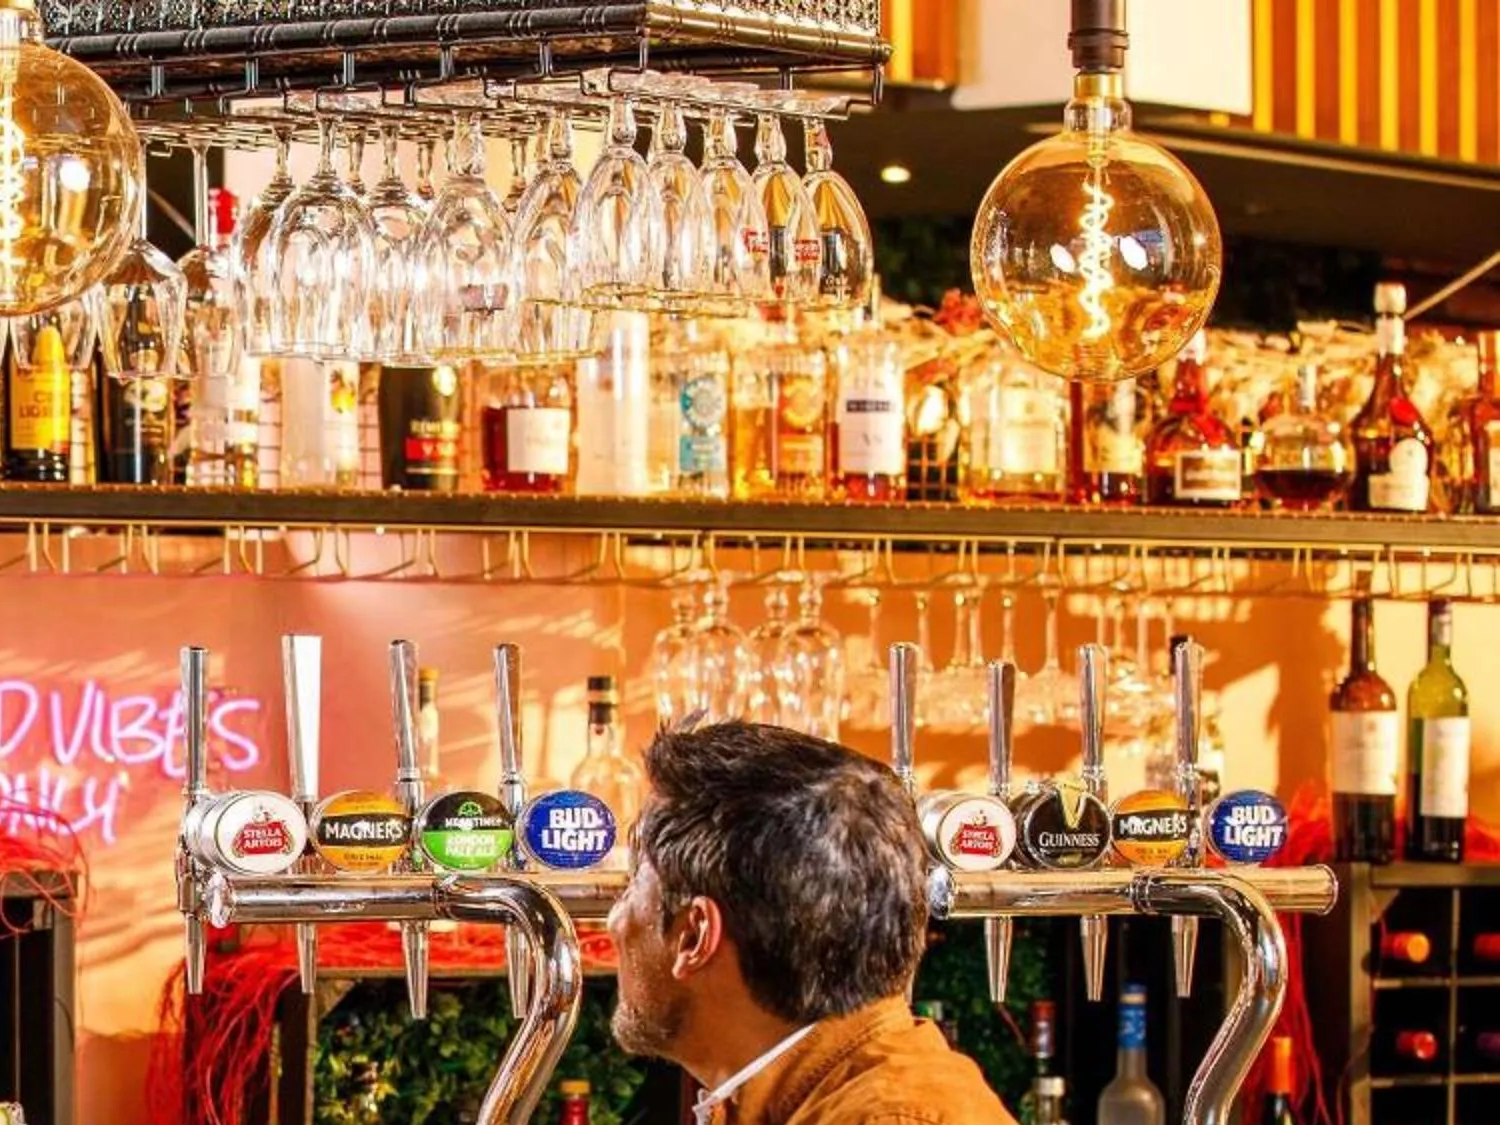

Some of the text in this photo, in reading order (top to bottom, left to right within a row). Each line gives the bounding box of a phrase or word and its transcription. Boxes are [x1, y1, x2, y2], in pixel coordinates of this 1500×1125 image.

[51, 678, 260, 779] VIBES
[549, 808, 598, 829] BUD
[1231, 805, 1276, 825] BUD
[325, 820, 403, 841] MAGNERS
[541, 829, 607, 851] LIGHT
[1039, 831, 1100, 848] GUINNESS
[1224, 825, 1283, 847] LIGHT
